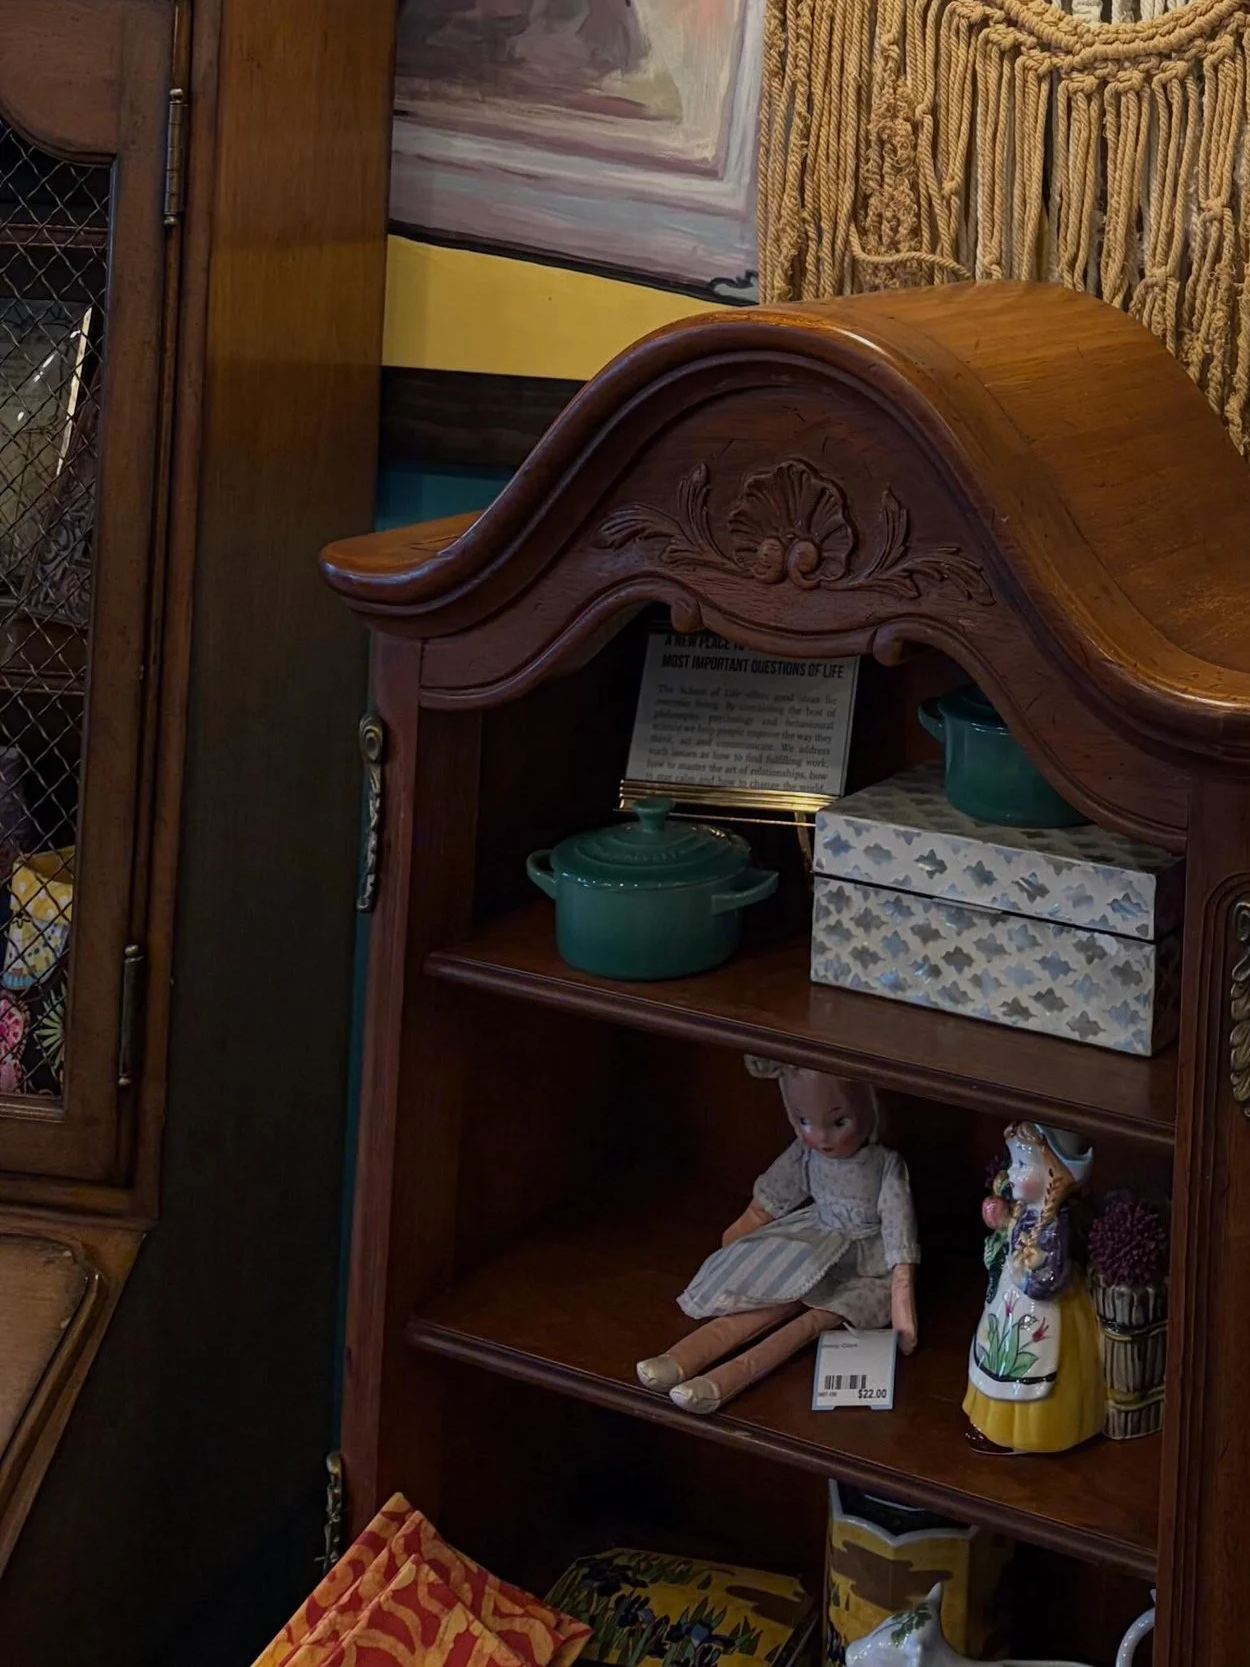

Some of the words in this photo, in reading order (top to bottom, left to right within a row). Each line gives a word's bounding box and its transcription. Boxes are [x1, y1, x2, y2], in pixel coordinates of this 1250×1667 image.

[661, 654, 690, 669] MOST
[692, 655, 749, 672] IMPORTANT
[750, 659, 806, 677] QUESTIONS
[807, 663, 822, 678] OF
[822, 664, 845, 680] LIFE
[858, 1389, 887, 1399] $22.00
